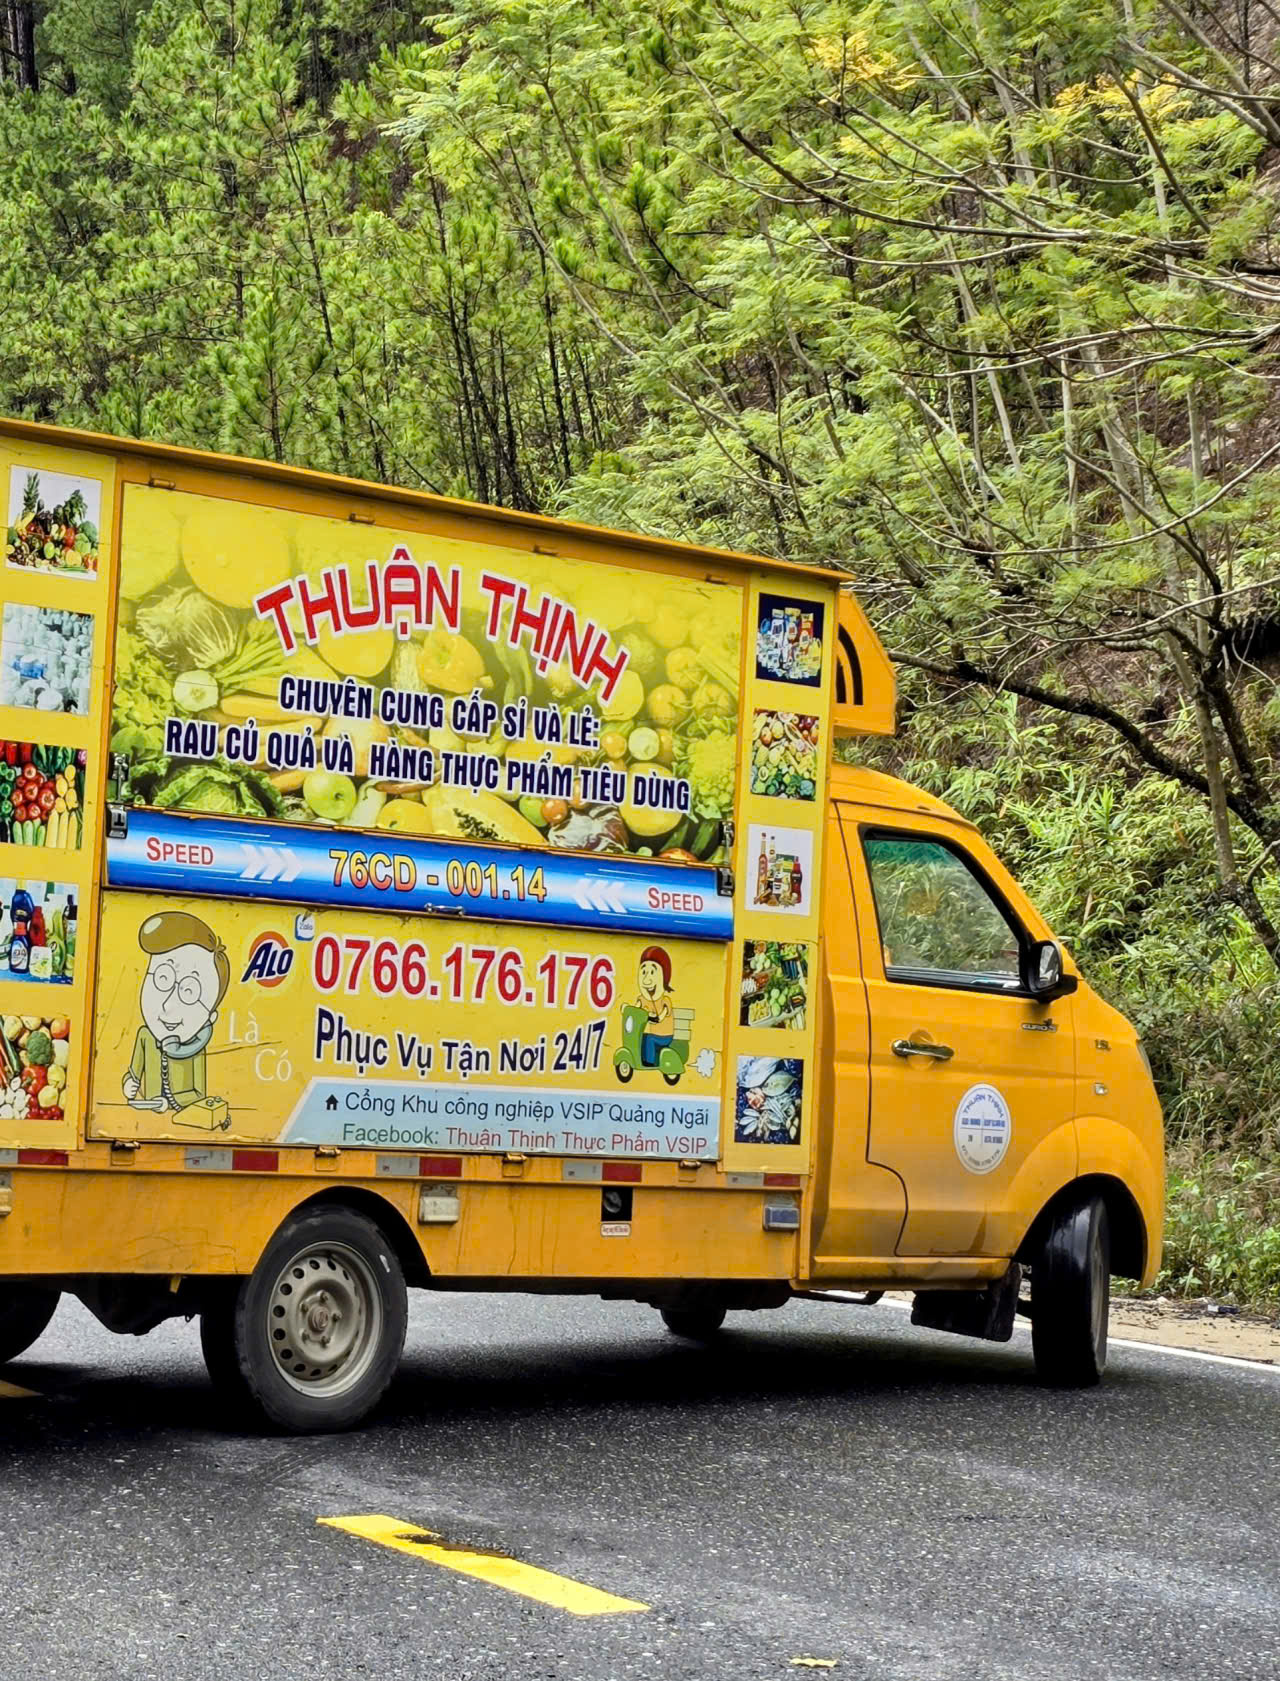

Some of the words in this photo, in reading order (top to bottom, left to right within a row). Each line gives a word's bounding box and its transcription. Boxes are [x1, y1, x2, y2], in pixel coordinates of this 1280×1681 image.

[256, 547, 460, 651] THUẬN
[481, 574, 628, 701] THỊNH
[280, 676, 373, 719] CHUYÊN
[381, 690, 444, 728] CUNG
[452, 690, 496, 734] CẤP
[503, 699, 526, 738] SỈ
[534, 705, 561, 743] VÀ
[569, 707, 600, 747] LẺ:
[166, 720, 218, 757] RAU
[226, 720, 258, 762] CỦ
[268, 727, 315, 769] QUẢ
[324, 735, 353, 773] VÀ
[370, 738, 433, 782] HÀNG
[442, 753, 499, 794] THỰC
[507, 751, 571, 797] PHẨM
[580, 766, 626, 803] TIÊU
[633, 772, 690, 811] DÙNG
[146, 836, 214, 866] SPEED
[328, 848, 418, 892] 76CD
[446, 859, 547, 904] 001.14
[647, 887, 704, 912] SPEED
[241, 941, 294, 983] ALO
[314, 936, 613, 1008] 0766.176.176
[229, 1010, 257, 1043] Là
[315, 1007, 388, 1073] Phục
[396, 1033, 432, 1076] Vụ
[441, 1041, 490, 1078] Tận
[500, 1037, 545, 1072] Nơi
[553, 1020, 606, 1071] 24/7
[255, 1048, 292, 1082] Có
[345, 1089, 395, 1117] Cổng
[402, 1094, 438, 1113] Khu
[444, 1097, 489, 1120] công
[495, 1100, 554, 1123] nghiệp
[560, 1101, 604, 1121] VSIP
[608, 1104, 665, 1128] Quảng
[671, 1107, 709, 1129] Ngãi
[343, 1123, 439, 1145] Facebook:
[508, 1129, 555, 1151] Thịnh
[562, 1131, 606, 1154] Thực
[611, 1131, 660, 1154] Phẩm
[665, 1136, 708, 1154] VSIP
